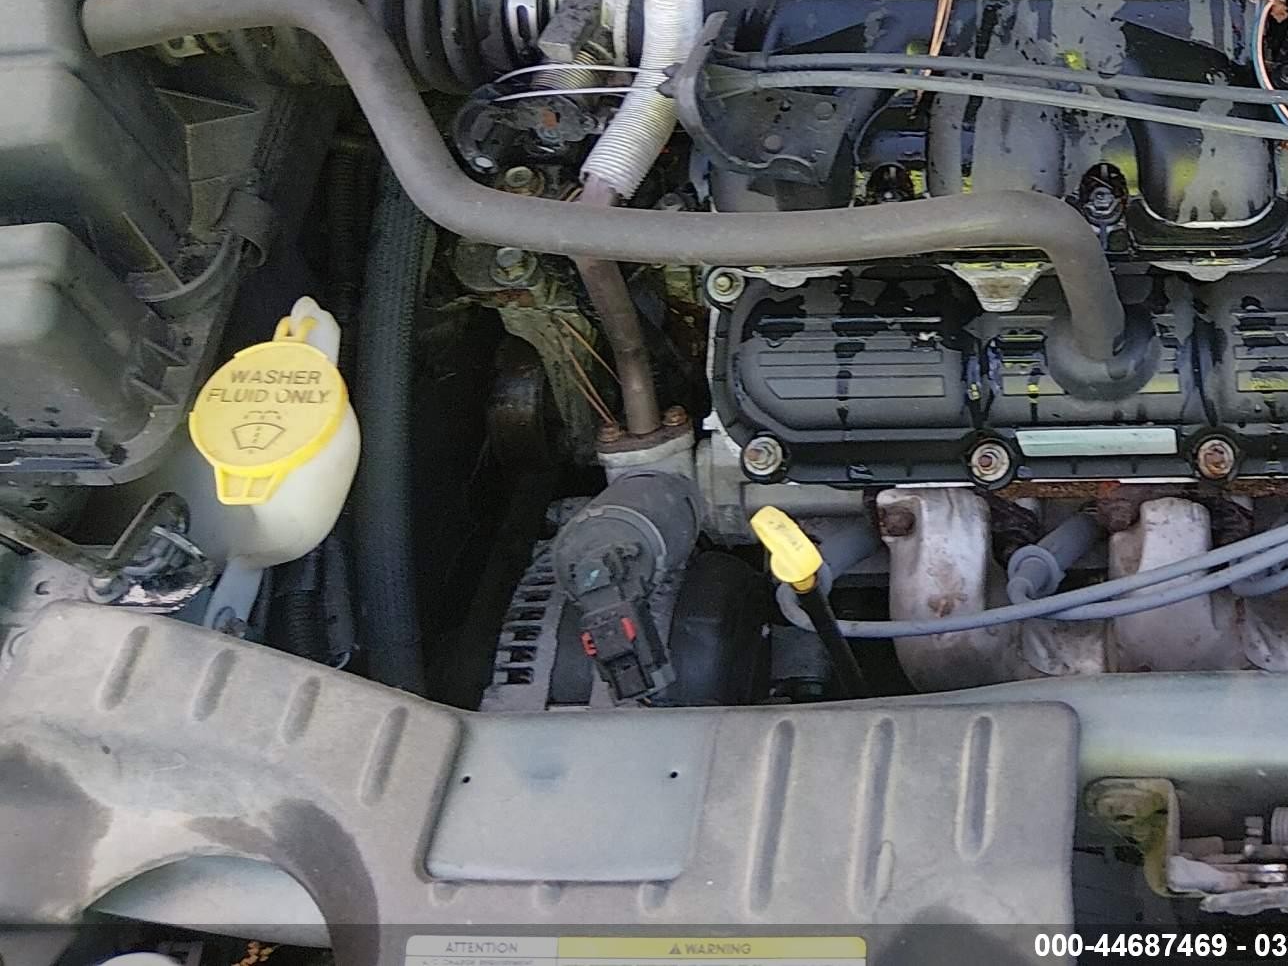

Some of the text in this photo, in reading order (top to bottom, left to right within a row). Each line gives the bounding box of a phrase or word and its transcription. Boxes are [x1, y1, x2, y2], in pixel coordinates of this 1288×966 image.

[231, 369, 322, 385] WASHER
[207, 388, 330, 404] FLUID ONLY
[445, 941, 518, 954] ATTENTION
[685, 943, 752, 955] WARNING
